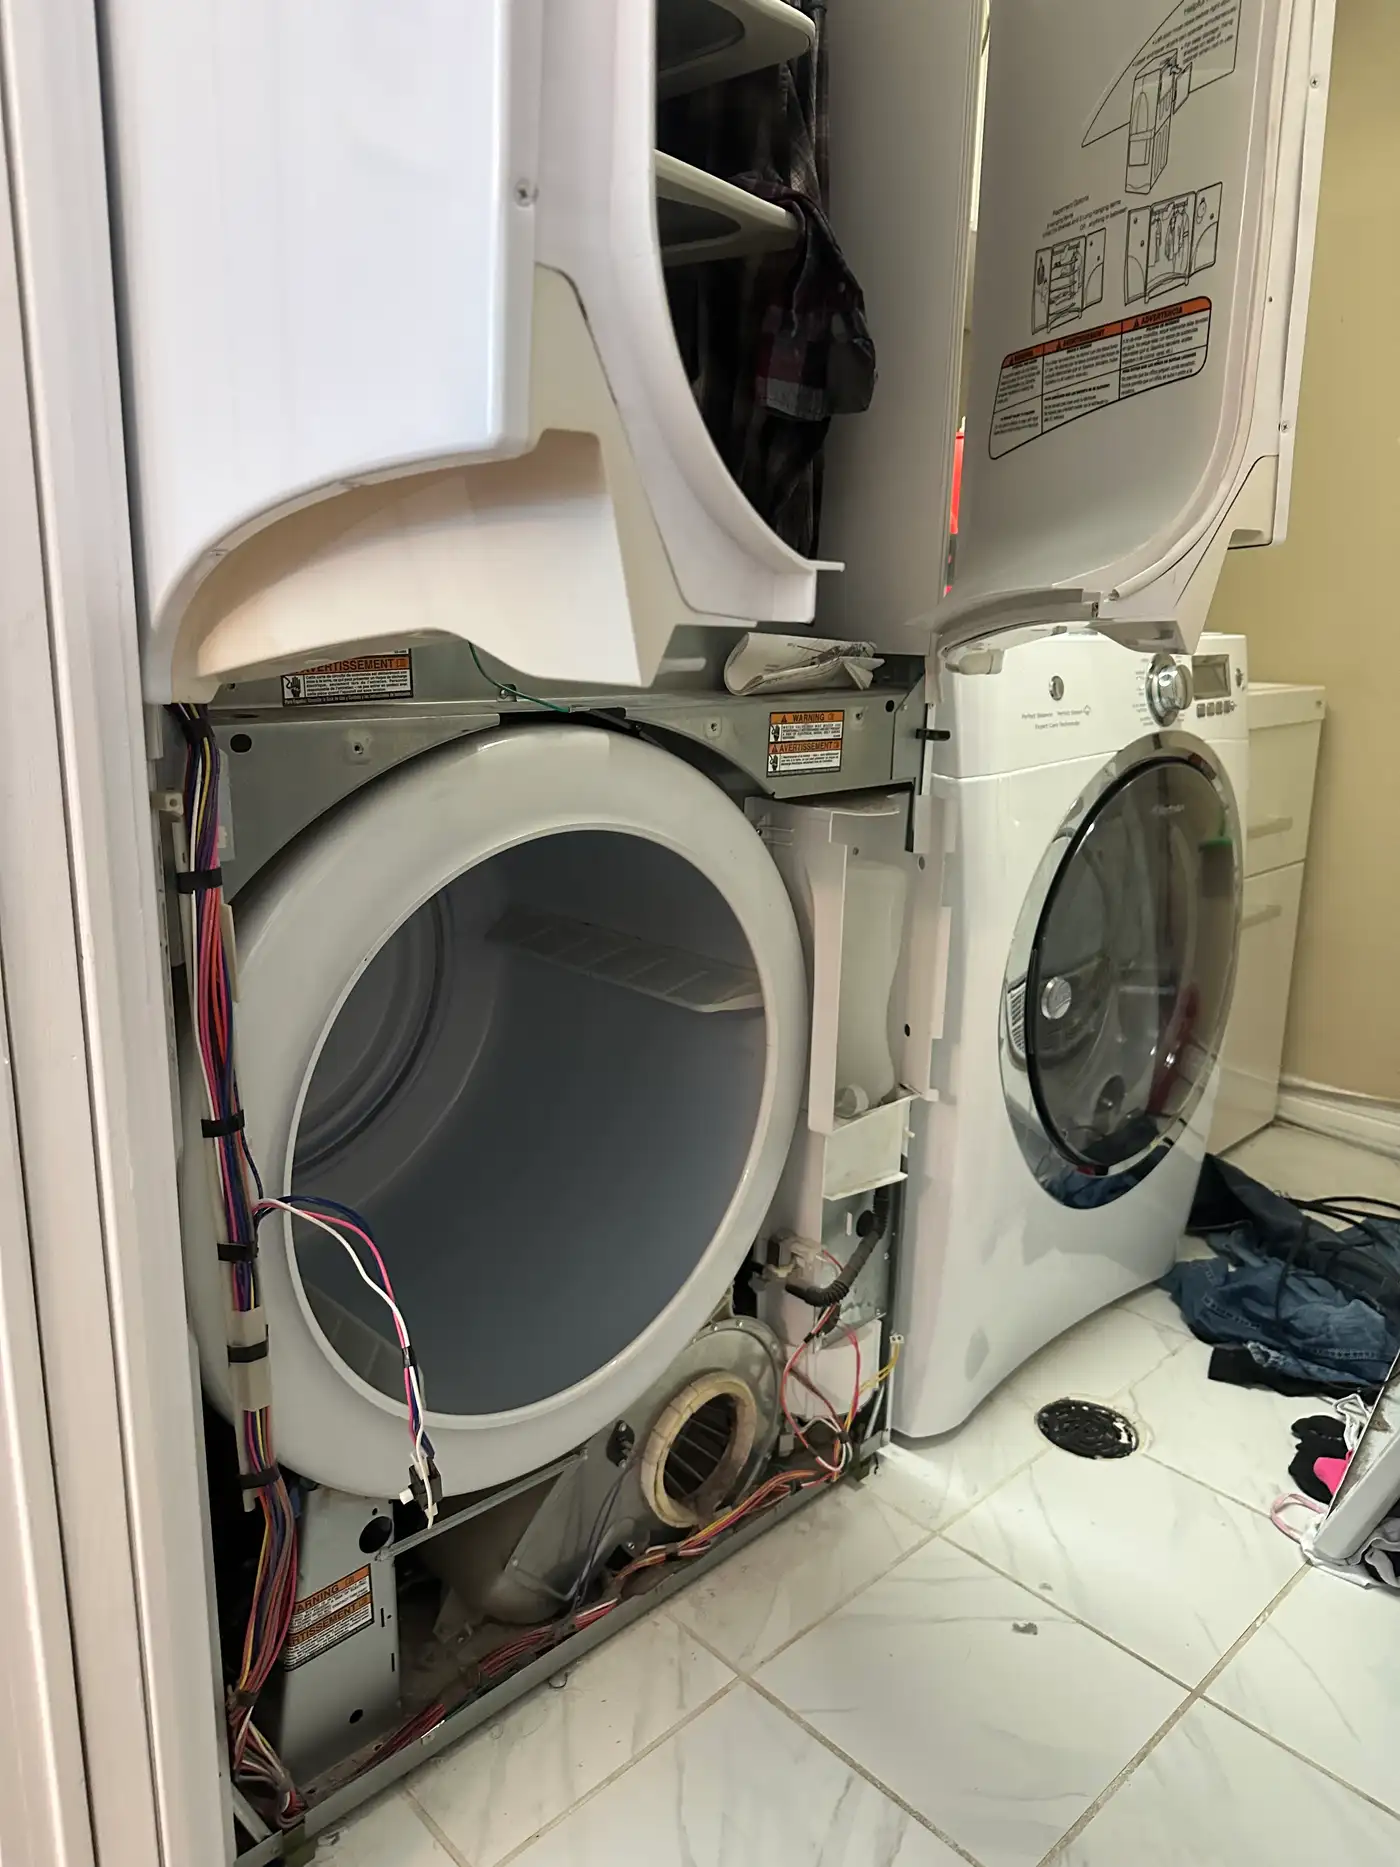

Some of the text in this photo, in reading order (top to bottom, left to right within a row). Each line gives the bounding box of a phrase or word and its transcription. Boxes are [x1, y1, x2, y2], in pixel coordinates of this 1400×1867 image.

[792, 714, 824, 722] WARNING
[780, 742, 832, 752] AVERTISSEMENT
[294, 1584, 339, 1613] ARNING
[291, 1603, 357, 1646] RTISSEMENT
